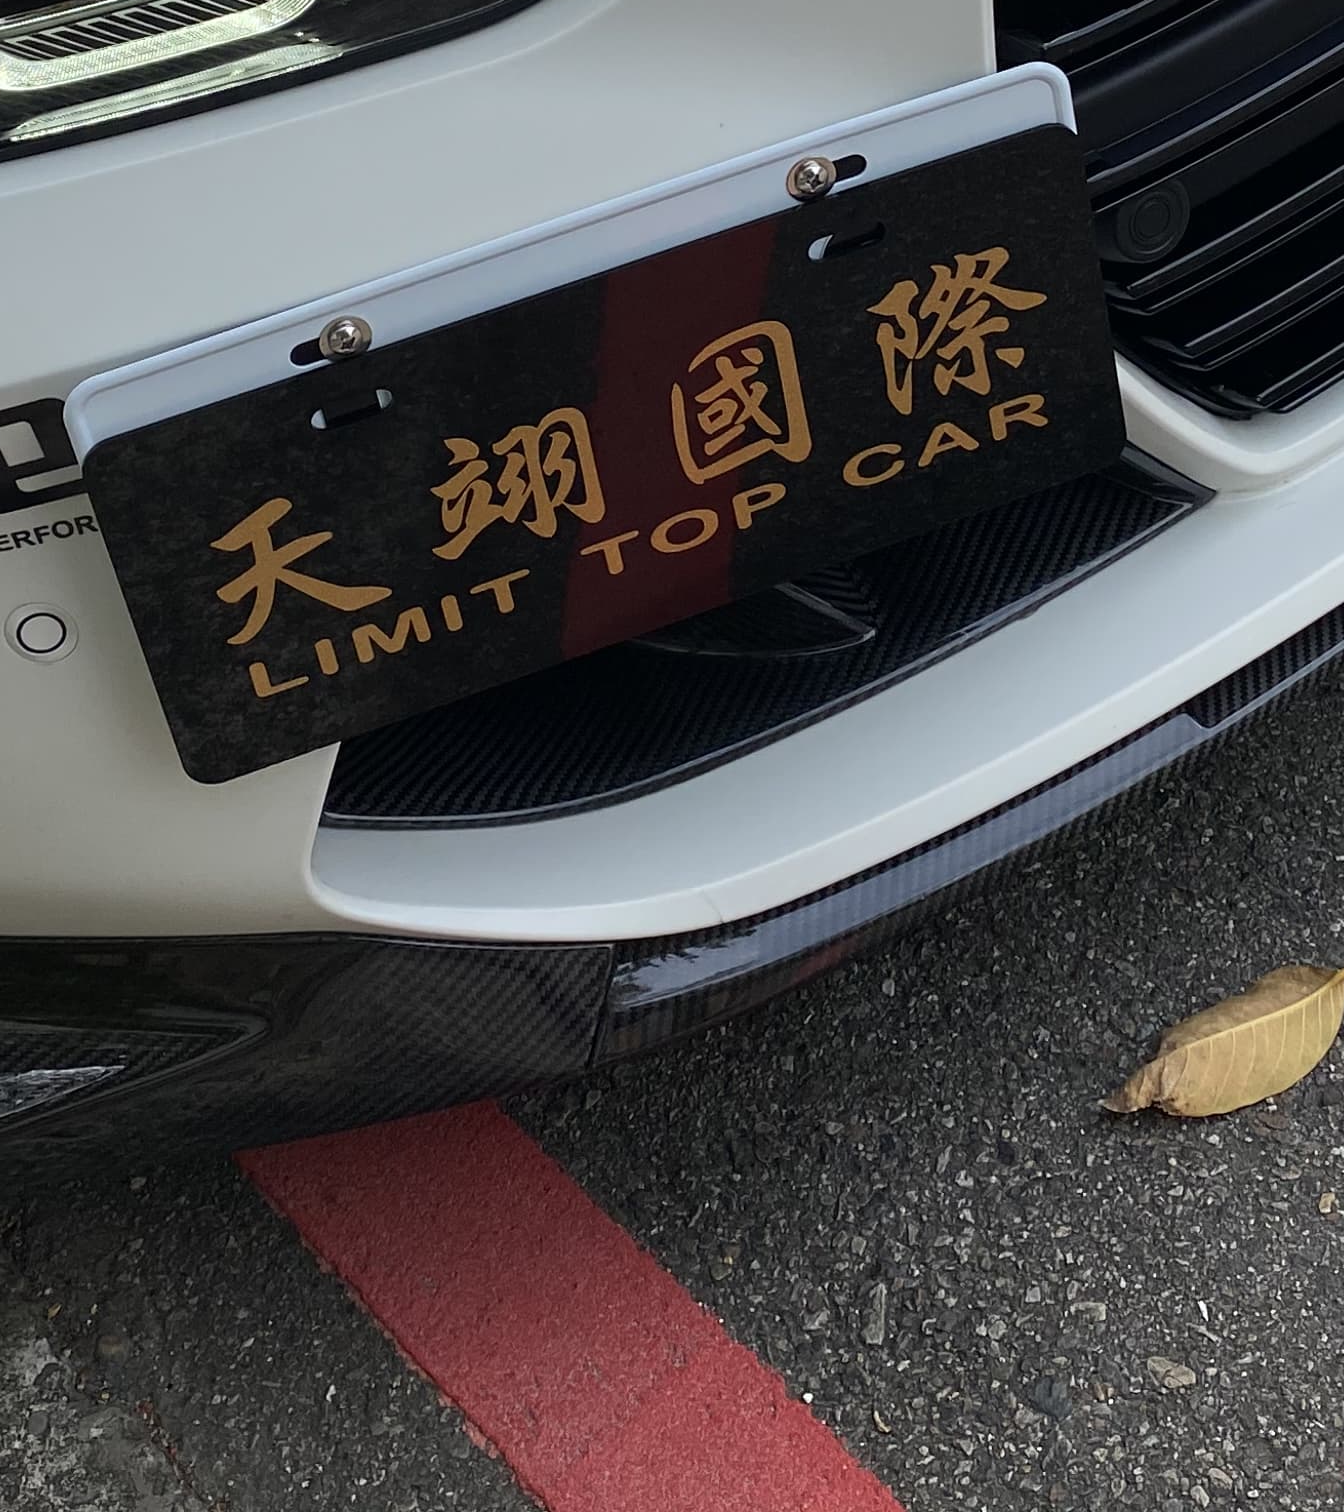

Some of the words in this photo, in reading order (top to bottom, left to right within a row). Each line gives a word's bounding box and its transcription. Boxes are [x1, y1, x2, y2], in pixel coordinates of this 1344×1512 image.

[213, 247, 1046, 645] 天翊國際
[250, 571, 528, 697] LIMIT
[583, 484, 785, 575] TOP
[843, 395, 1047, 486] CAR
